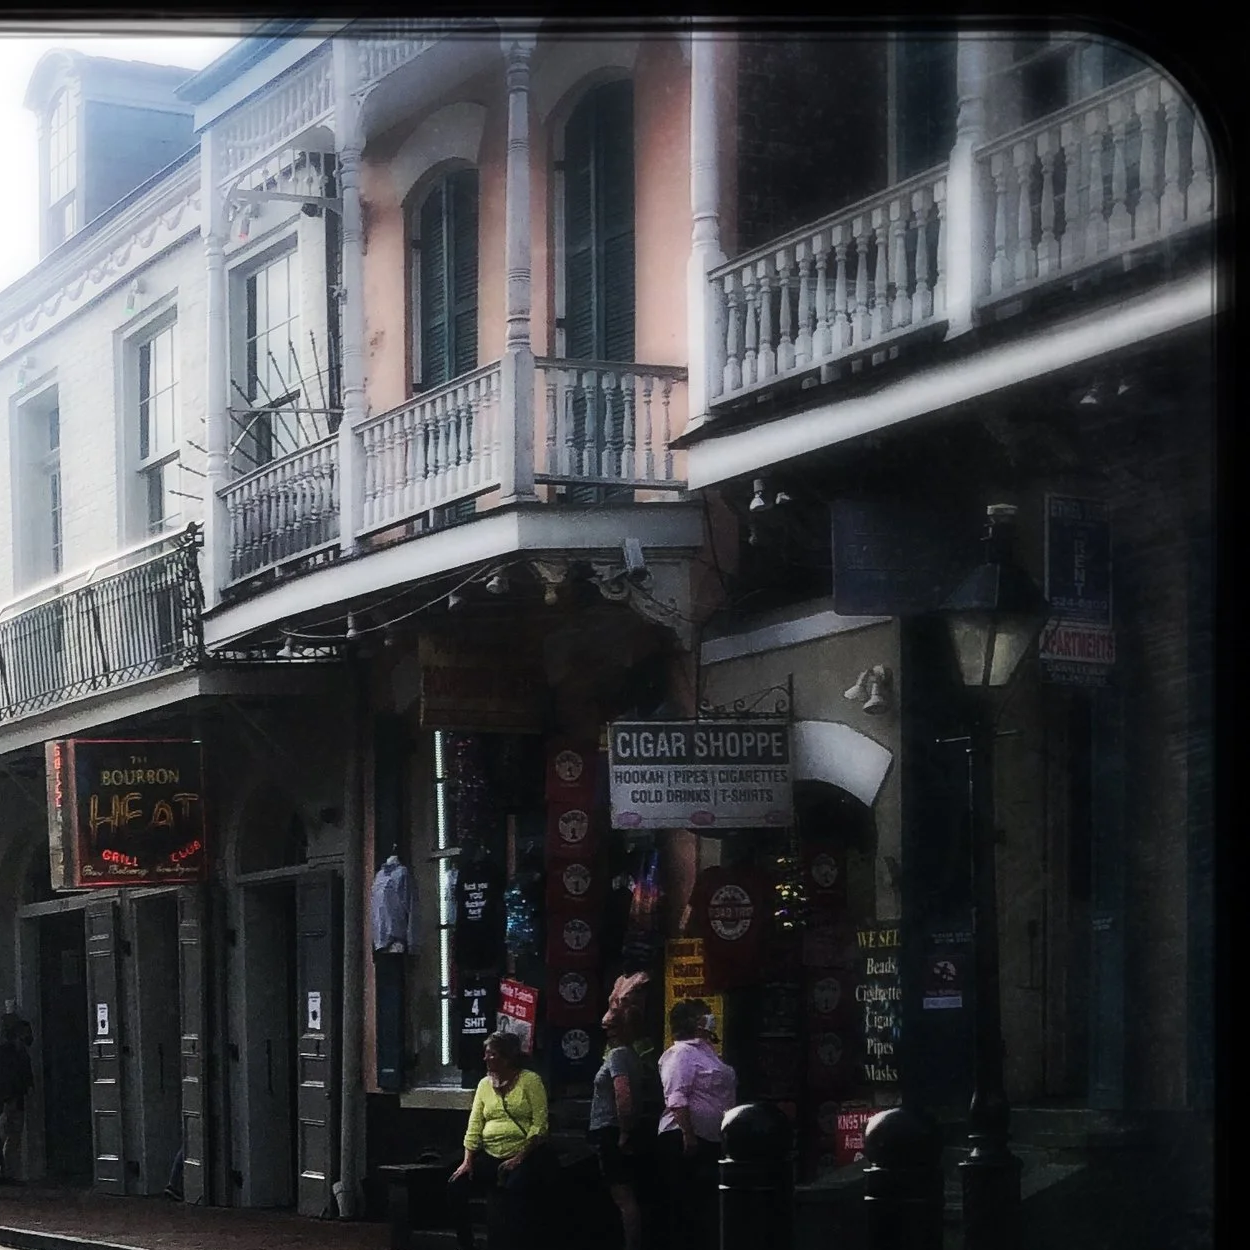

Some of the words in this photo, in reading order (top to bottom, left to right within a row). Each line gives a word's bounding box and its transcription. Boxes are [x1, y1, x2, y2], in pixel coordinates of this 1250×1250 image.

[616, 731, 687, 758] CIGAR
[694, 731, 783, 758] SHOPPE
[101, 768, 180, 786] BOURBON
[614, 770, 664, 784] HOOKAH
[674, 770, 709, 784] PIPES
[718, 769, 787, 783] CIGARETTES
[631, 790, 662, 804] COLD
[666, 789, 711, 803] DRINKS
[721, 788, 773, 803] T-SHIRTS
[101, 849, 139, 867] GRILL
[170, 840, 201, 863] CLUB
[856, 930, 876, 948] WE
[878, 927, 902, 947] SEL
[471, 998, 480, 1016] 4
[464, 1017, 487, 1028] SHIT
[867, 1037, 894, 1059] Pipes
[864, 1064, 899, 1081] Masks
